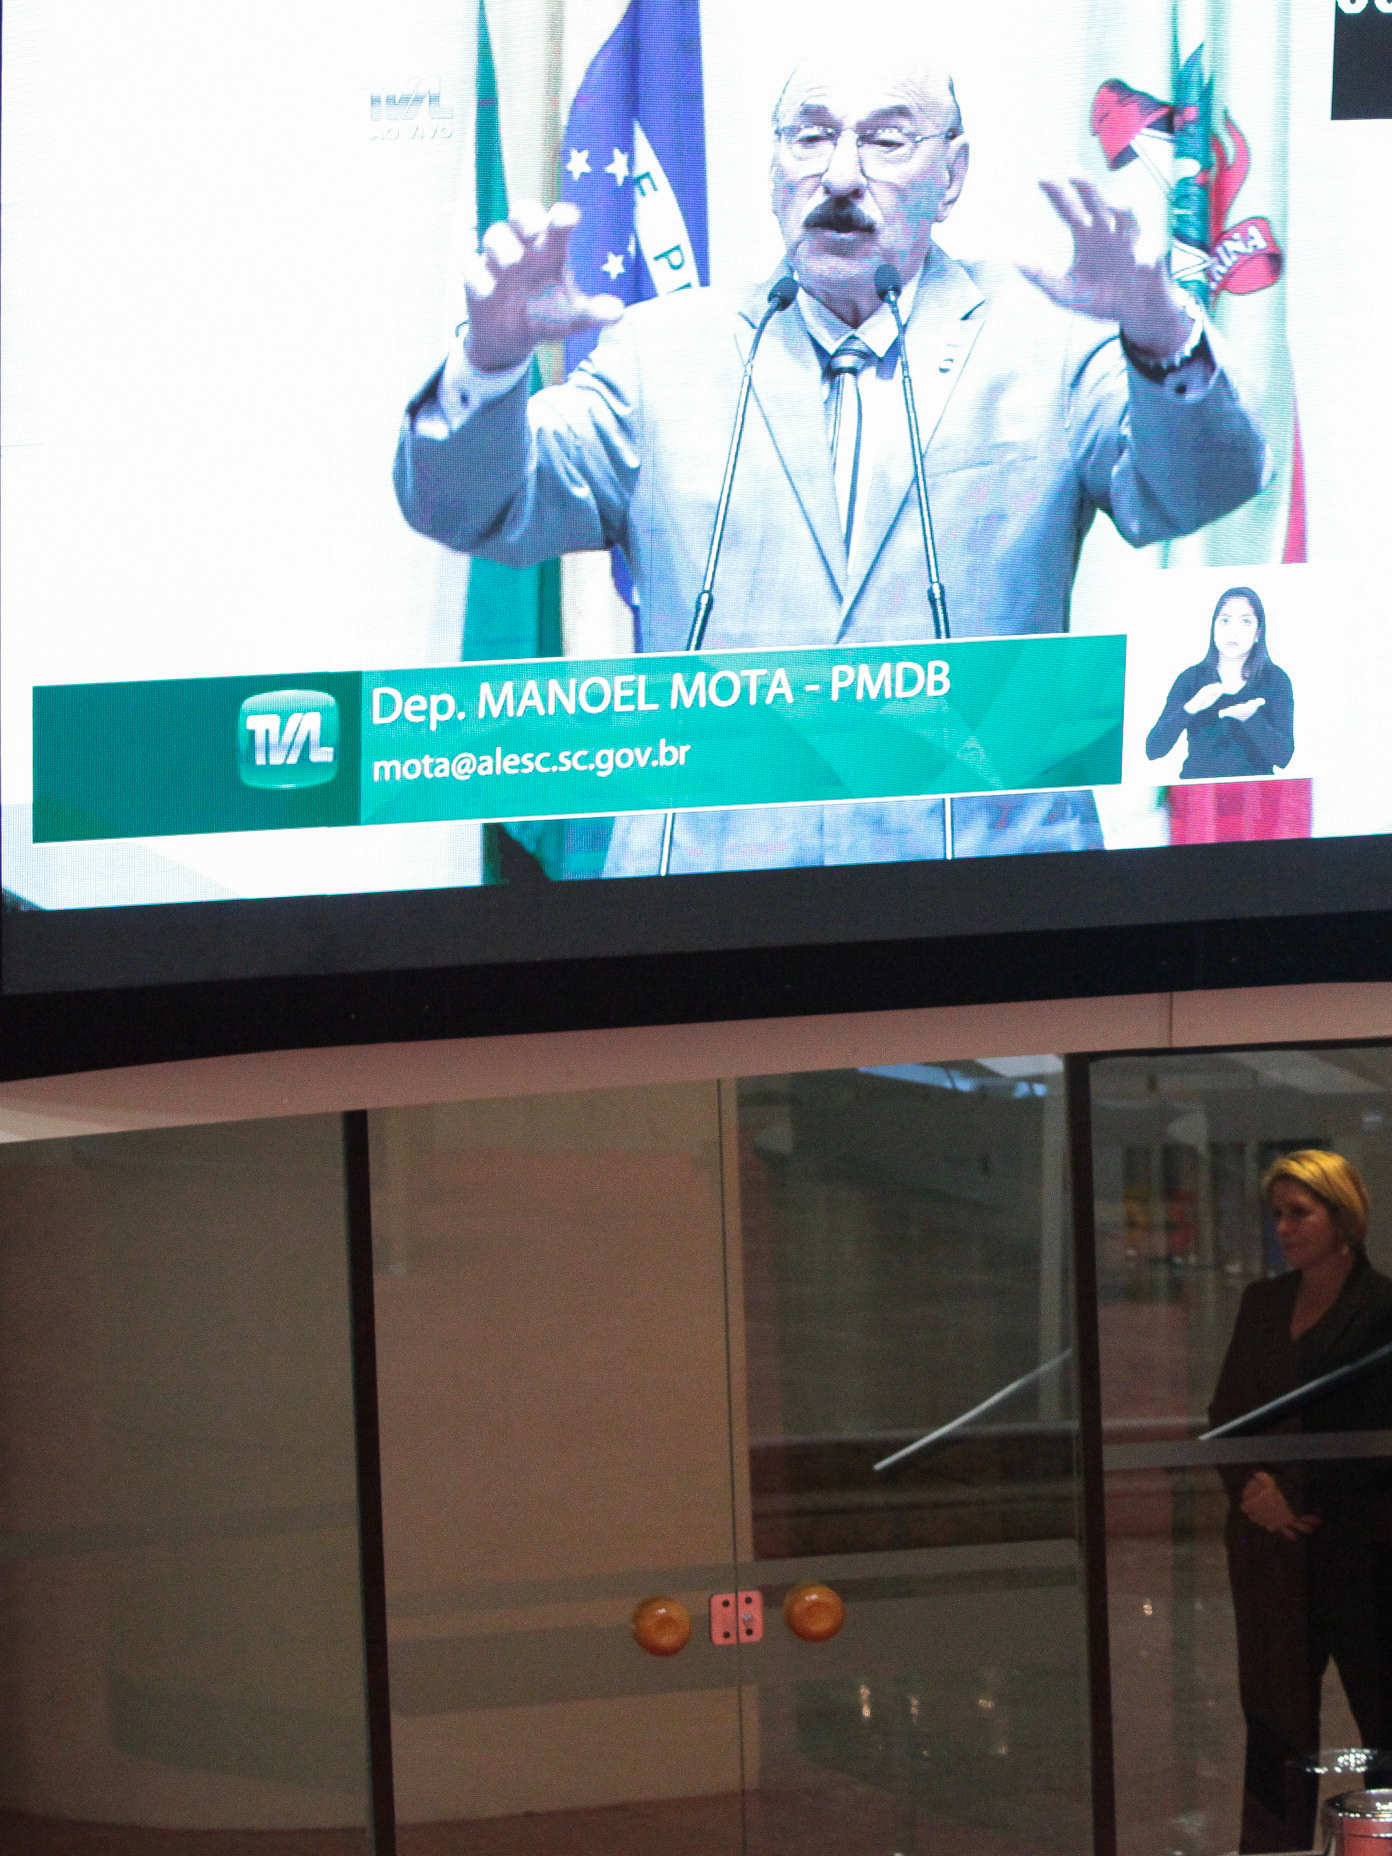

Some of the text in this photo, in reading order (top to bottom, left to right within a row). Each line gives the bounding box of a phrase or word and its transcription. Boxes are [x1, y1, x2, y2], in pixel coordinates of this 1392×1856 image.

[372, 686, 466, 732] Dep.
[478, 674, 659, 718] MANOEL
[670, 667, 794, 709] MOTA
[831, 660, 951, 701] PMDB
[373, 737, 691, 782] mota@alesc.sc.gov.br
